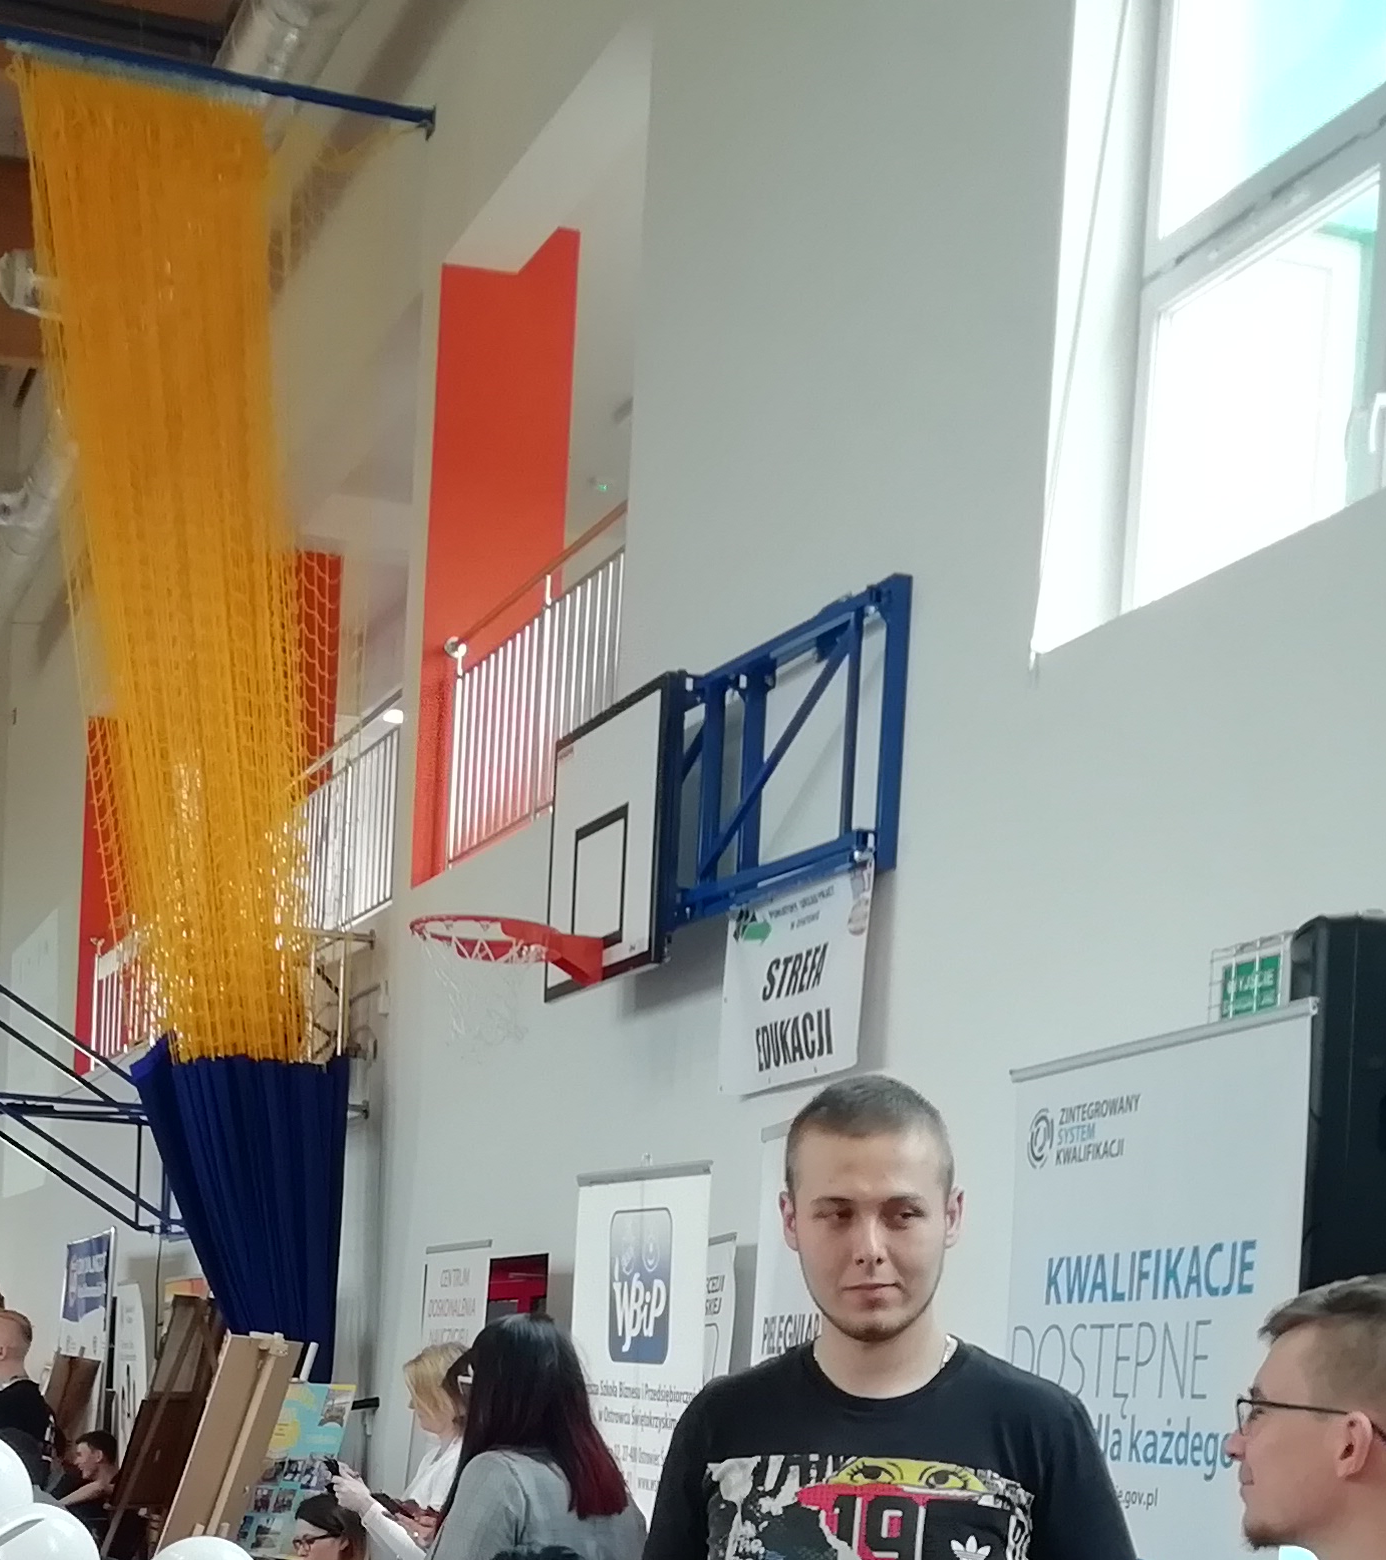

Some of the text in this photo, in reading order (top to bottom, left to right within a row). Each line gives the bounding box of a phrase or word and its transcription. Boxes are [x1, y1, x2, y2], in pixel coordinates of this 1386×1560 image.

[763, 942, 828, 1001] STREFA
[755, 1008, 833, 1072] EDUKACJI
[1057, 1123, 1095, 1145] SYSTEM
[1059, 1093, 1141, 1125] ZINTEGROWANY
[1055, 1138, 1124, 1166] KWALIFIKACJI
[1044, 1239, 1257, 1305] KWALIFIKACJE
[1012, 1319, 1212, 1419] DOSTĘPNE
[1128, 1414, 1234, 1481] każdego
